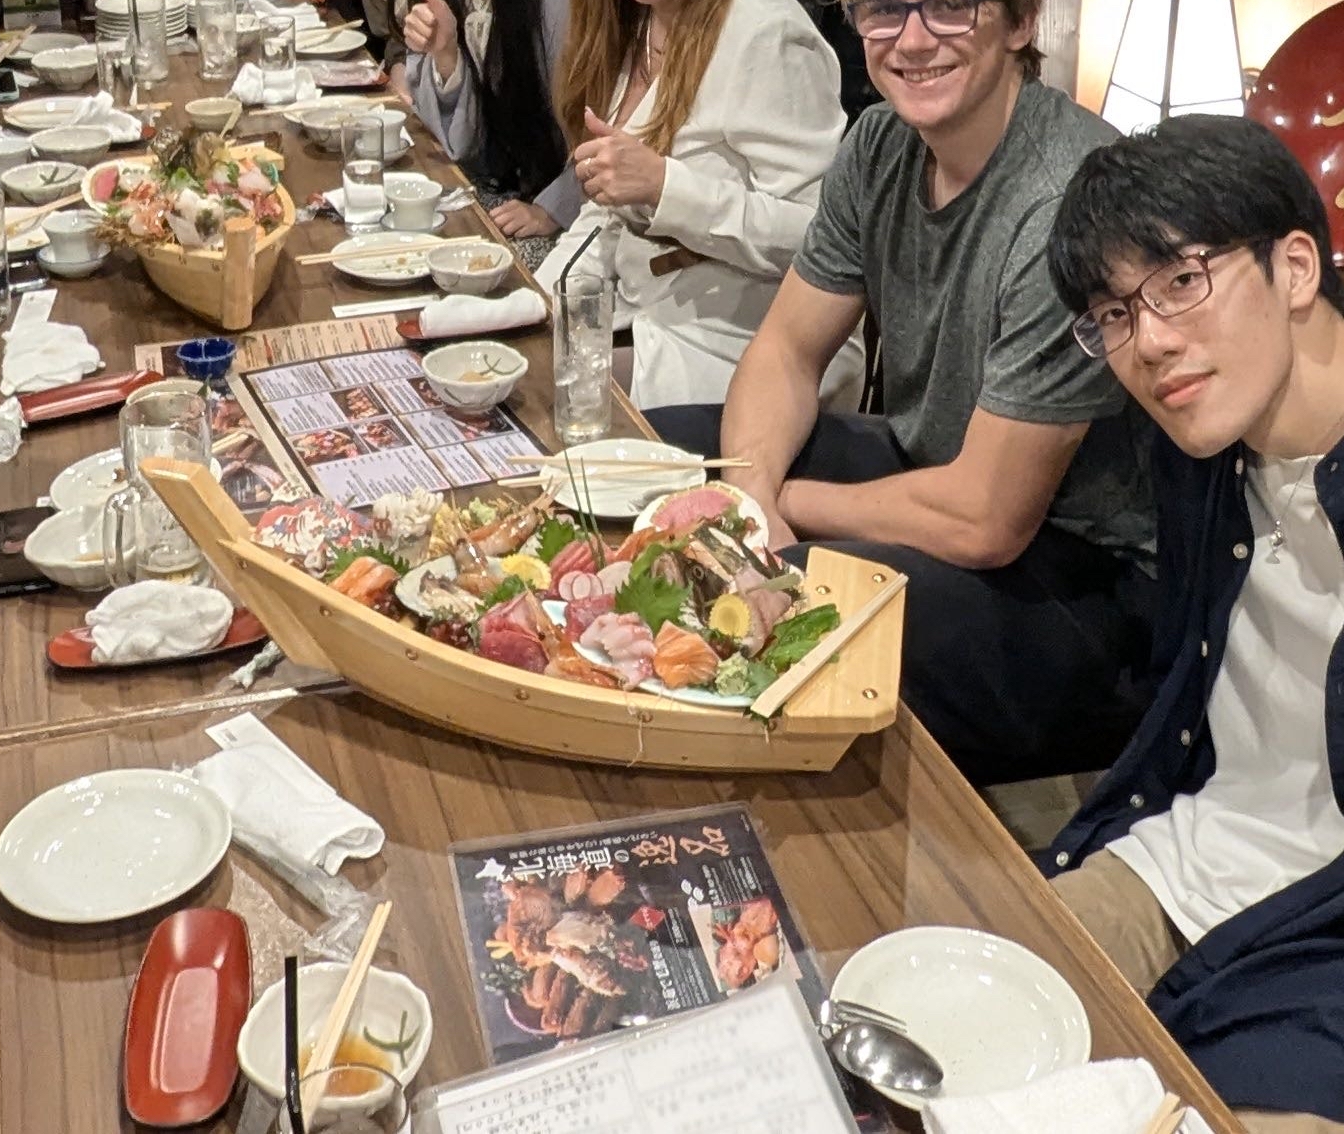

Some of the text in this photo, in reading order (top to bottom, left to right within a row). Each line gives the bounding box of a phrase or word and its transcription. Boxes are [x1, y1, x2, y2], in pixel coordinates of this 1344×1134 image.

[512, 825, 730, 880] 北海道の逸品
